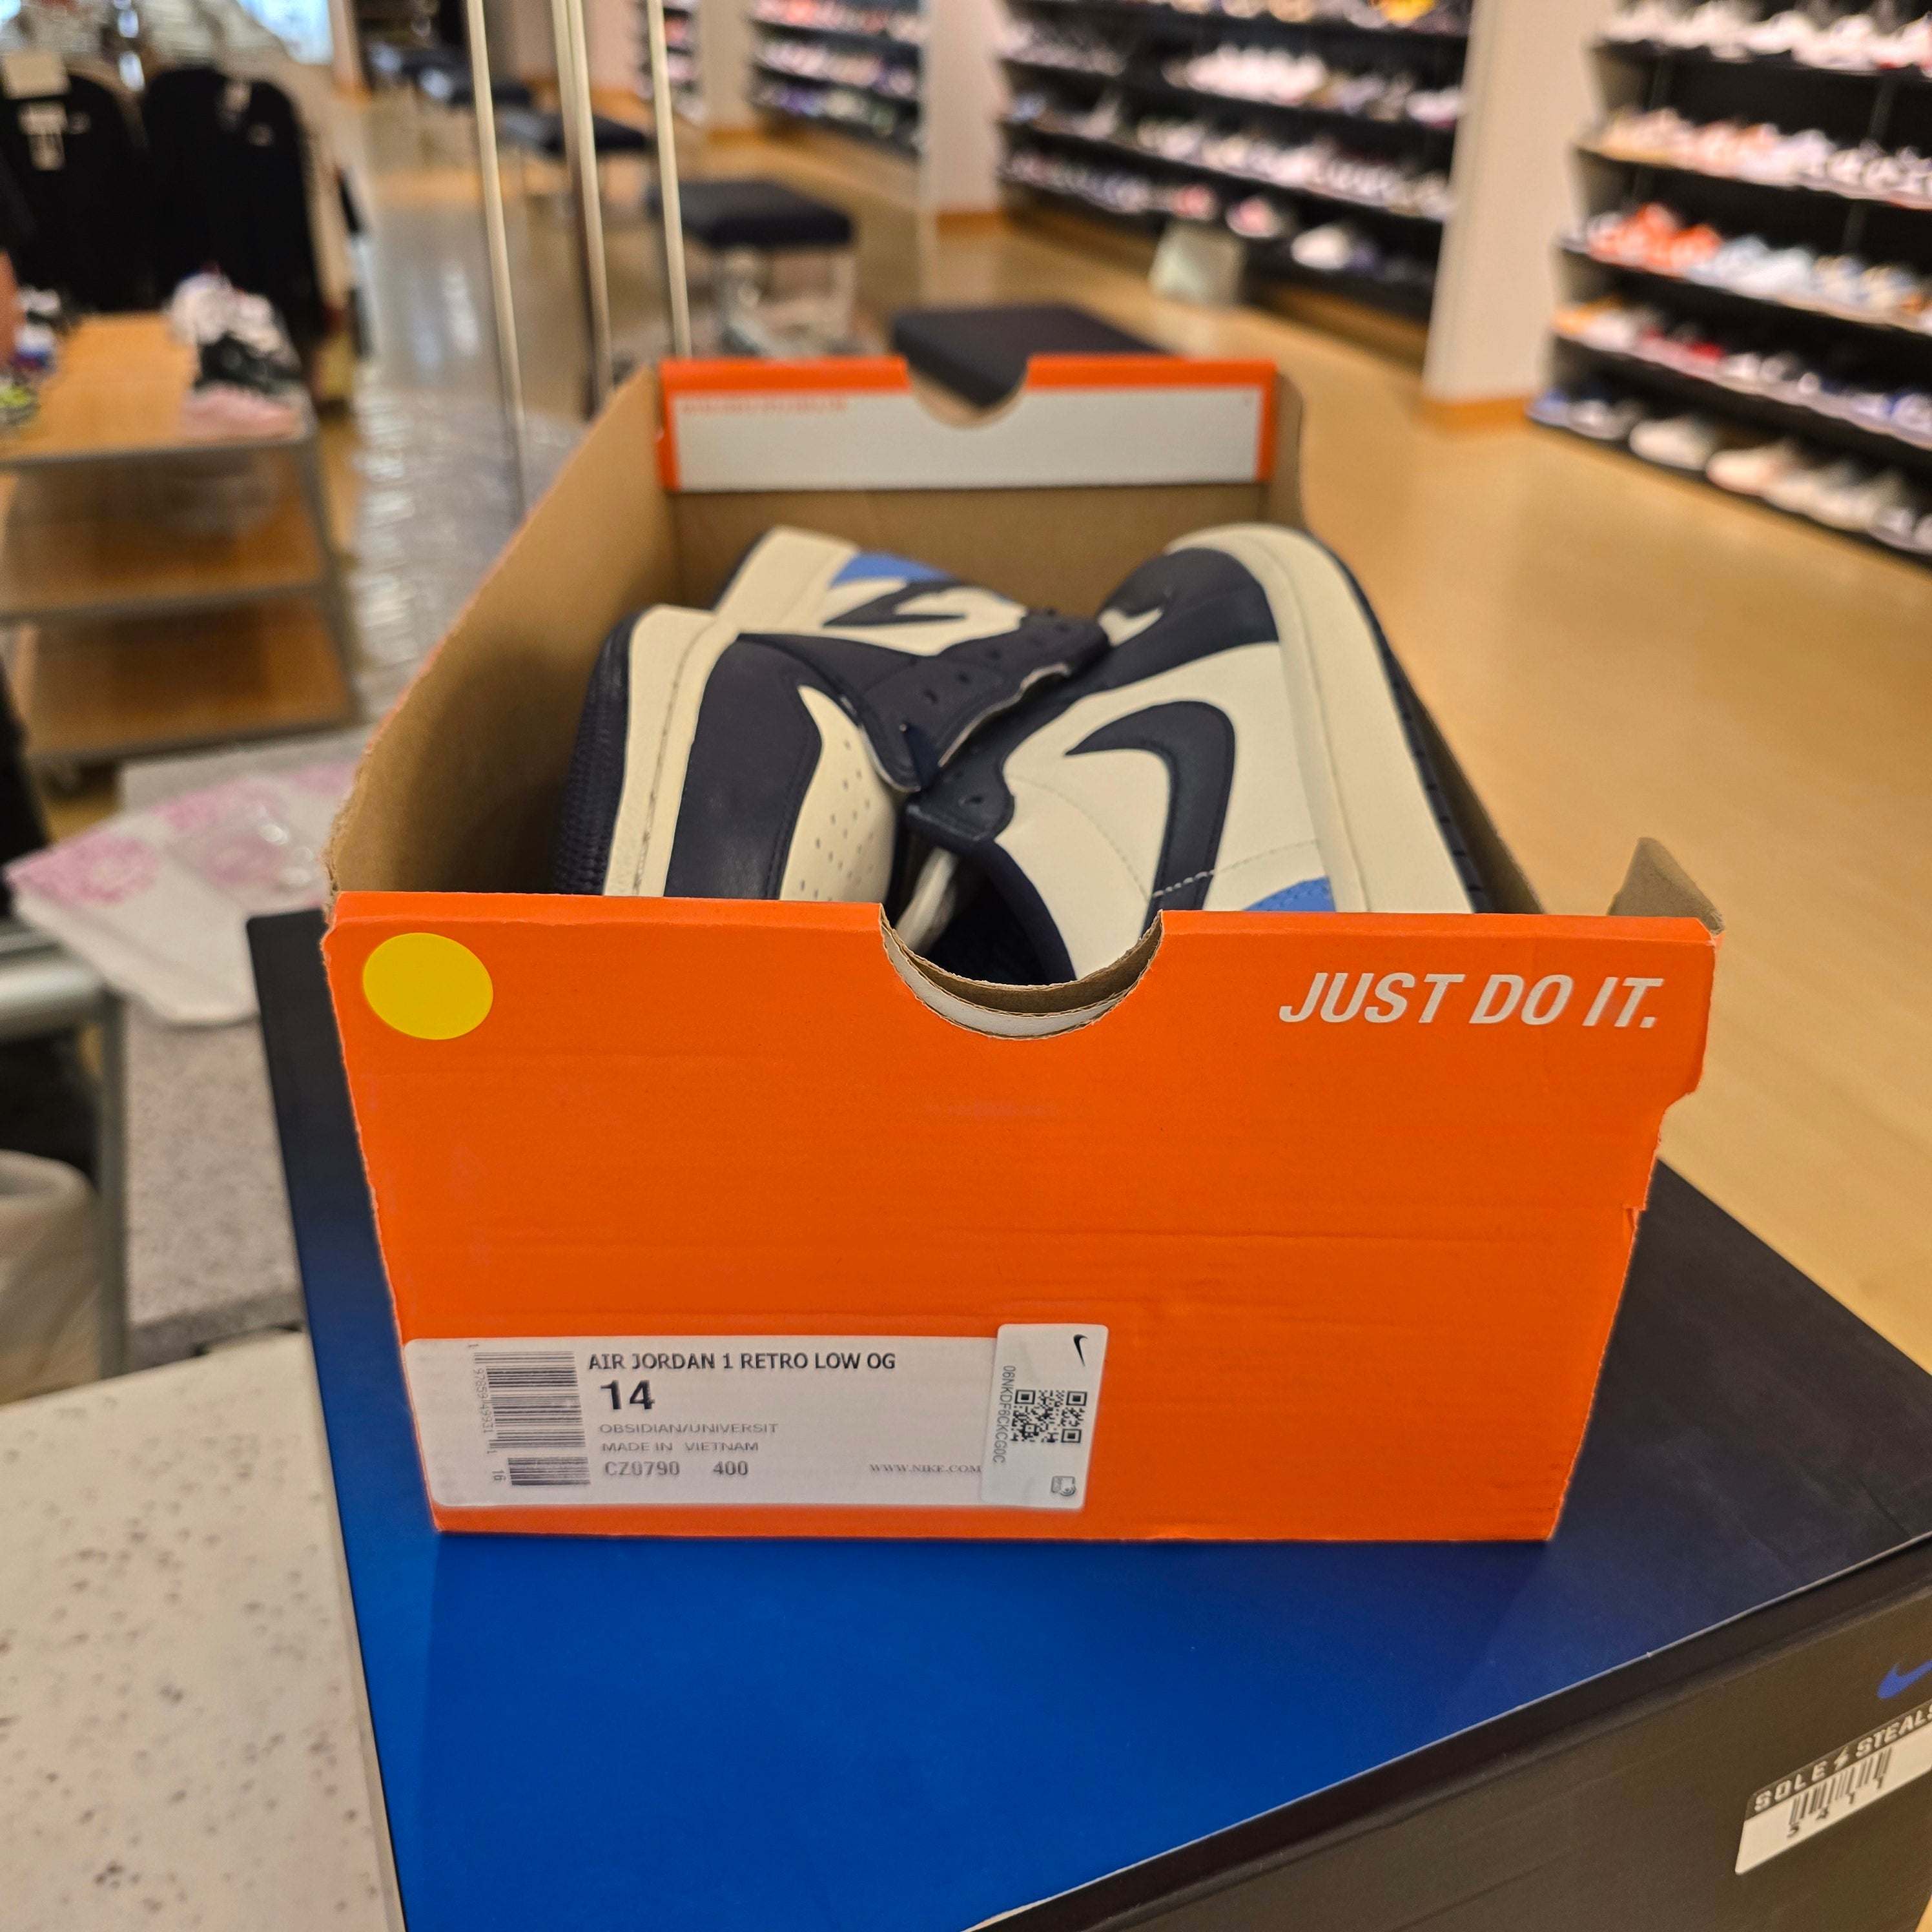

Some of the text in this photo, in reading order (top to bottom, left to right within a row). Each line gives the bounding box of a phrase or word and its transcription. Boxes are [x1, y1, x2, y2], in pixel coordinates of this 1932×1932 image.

[1279, 972, 1664, 1028] JUST DO IT.
[588, 1352, 896, 1370] AIR JORDAN 1 RETRO LOW OG
[600, 1379, 655, 1410] 14
[599, 1423, 779, 1434] OBSIDIAN/UNIVERSIT
[602, 1441, 759, 1452] MADE IN VIETNAM
[492, 1469, 507, 1482] 16
[604, 1460, 748, 1476] CZ0790 400
[1754, 1760, 1828, 1813] SOLE
